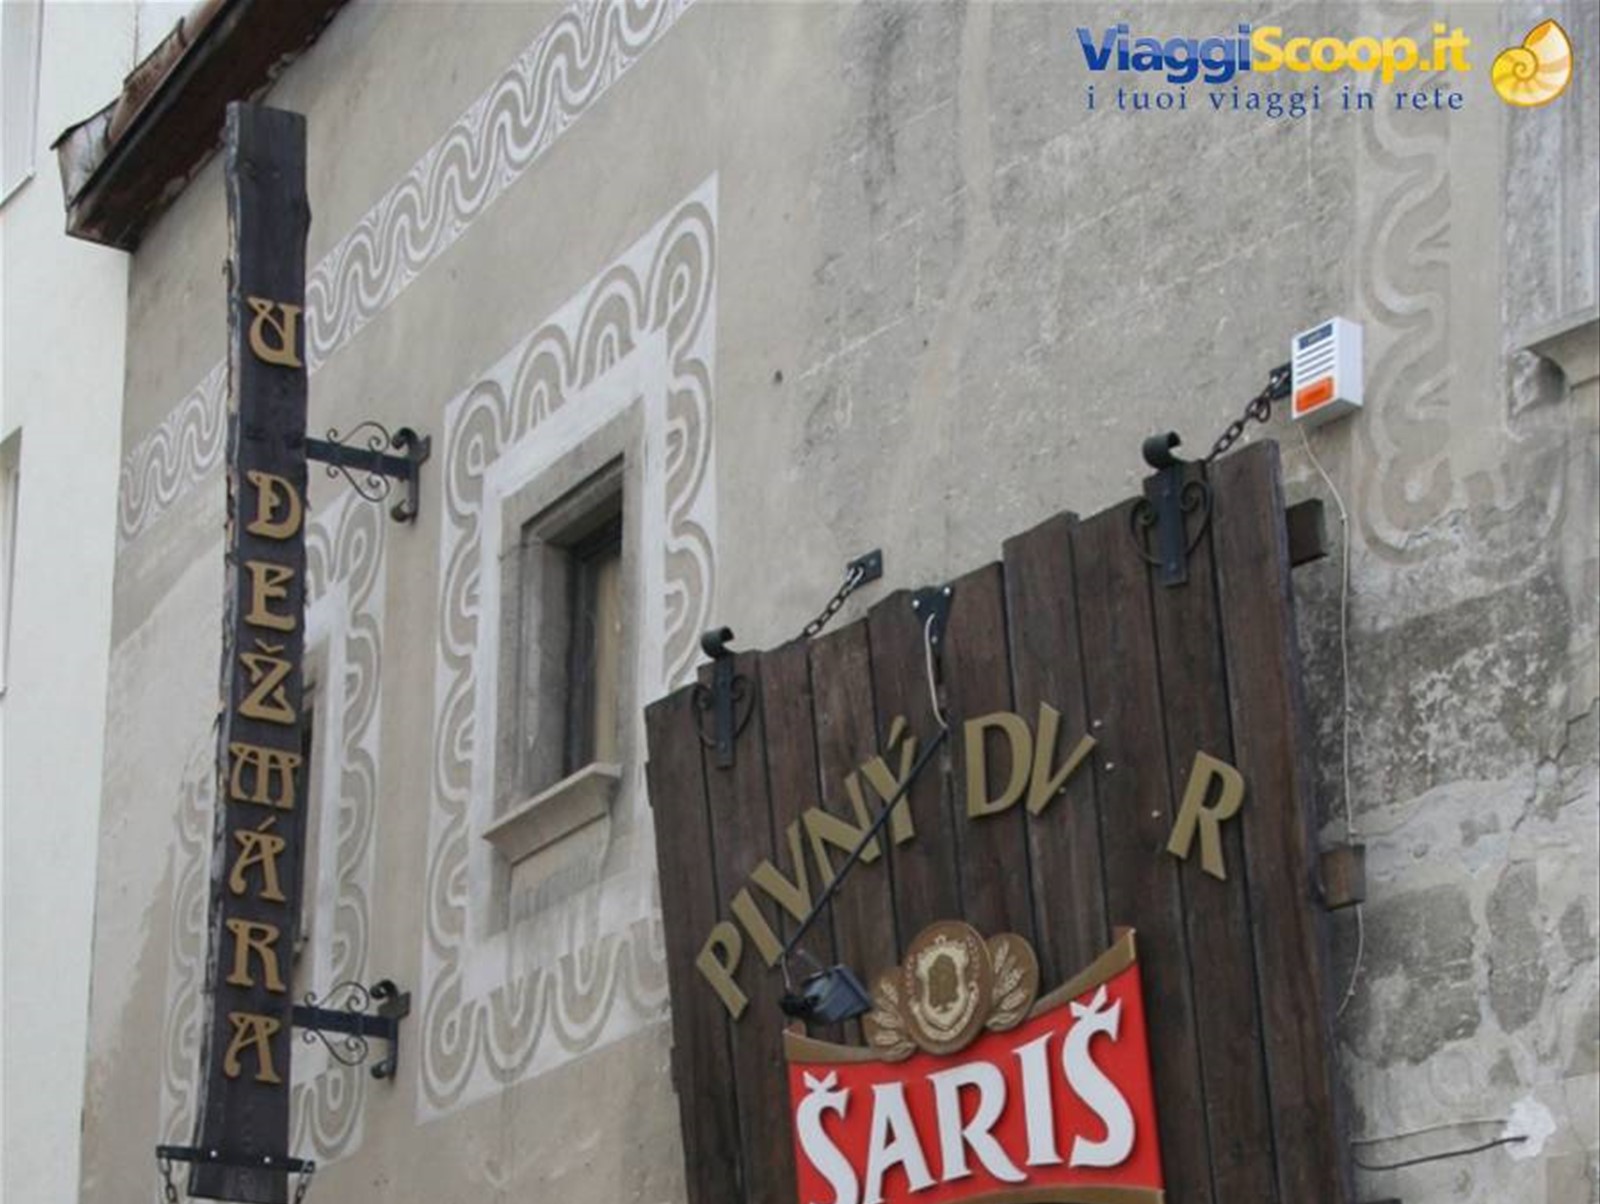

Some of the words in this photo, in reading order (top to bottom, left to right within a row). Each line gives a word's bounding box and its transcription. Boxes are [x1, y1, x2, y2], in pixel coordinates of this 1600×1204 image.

[248, 297, 303, 367] U
[223, 470, 304, 1084] DEŽMÁRA
[696, 715, 917, 1021] PIVNÝ
